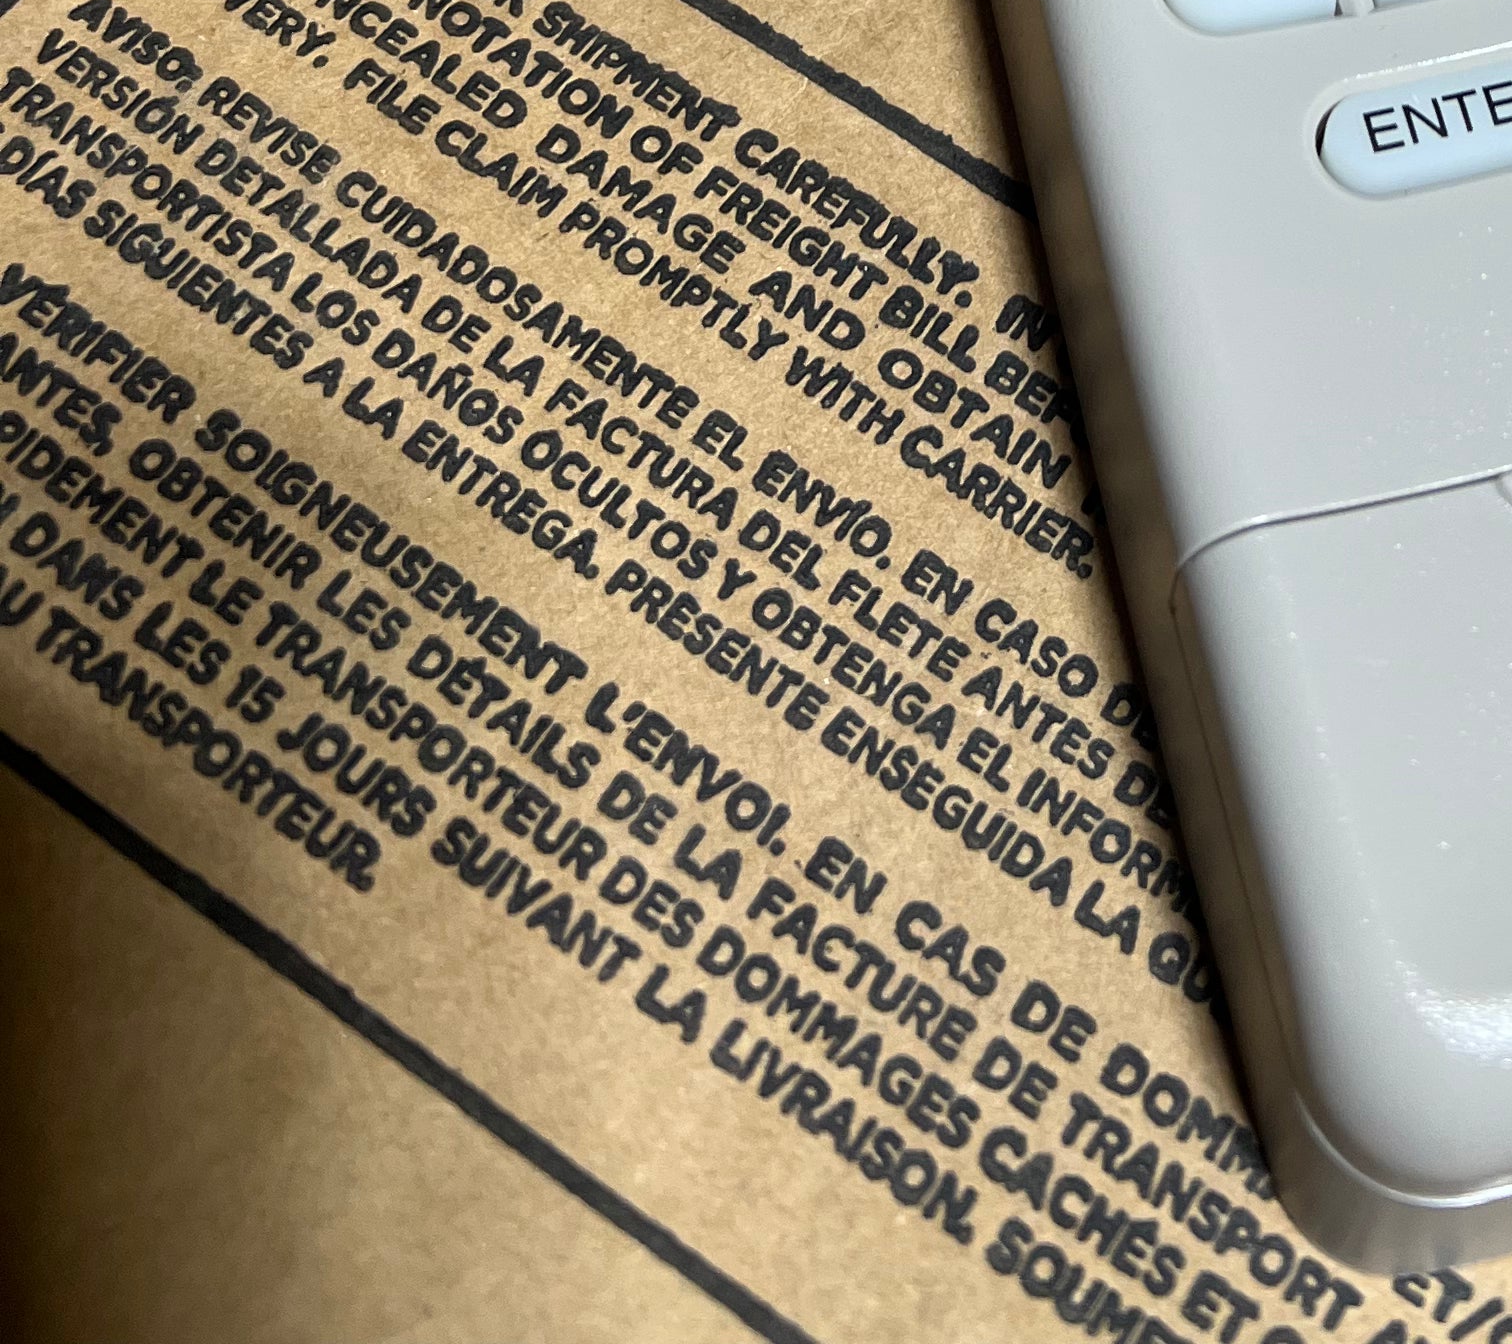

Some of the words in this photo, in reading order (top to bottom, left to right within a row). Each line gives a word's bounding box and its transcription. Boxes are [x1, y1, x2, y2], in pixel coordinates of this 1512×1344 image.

[197, 76, 342, 185] REVISE
[335, 169, 700, 430] CUIDADOSAMENTE
[690, 409, 748, 472] EL
[901, 548, 975, 616] EN
[974, 597, 1099, 698] CASO
[342, 58, 441, 137] FILE
[434, 120, 568, 219] CLAIM
[557, 198, 789, 363] PROMPTLY
[784, 345, 906, 446] WITH
[899, 425, 1094, 580] CARRIER.
[532, 0, 743, 142] SHIPMENT
[734, 127, 980, 308] CAREFULLY.
[535, 123, 747, 275] DAMAGE
[748, 271, 879, 351] AND
[877, 348, 1073, 489] OBTAIN
[630, 125, 704, 176] OF
[693, 166, 889, 301] FREIGHT
[878, 285, 979, 374] BILL
[194, 138, 422, 314] DETALLADA
[420, 295, 491, 355] DE
[482, 335, 545, 398] LA
[543, 378, 739, 532] FACTURA
[737, 509, 824, 592] DEL
[827, 569, 972, 683] FLETE
[961, 653, 1115, 780] ANTES
[11, 513, 144, 621] DANS
[134, 602, 231, 685] LES
[225, 665, 285, 724] 15
[276, 714, 436, 838] JOURS
[430, 817, 643, 984] SUIVANT
[633, 964, 706, 1046] LA
[708, 1019, 978, 1247] LIVRAISON.
[35, 608, 381, 894] TRANSPORTEUR.
[194, 408, 589, 695] SOIGNEUSEMENT
[794, 836, 888, 915] EN
[894, 900, 1007, 999] CAS
[1010, 980, 1098, 1064] DE
